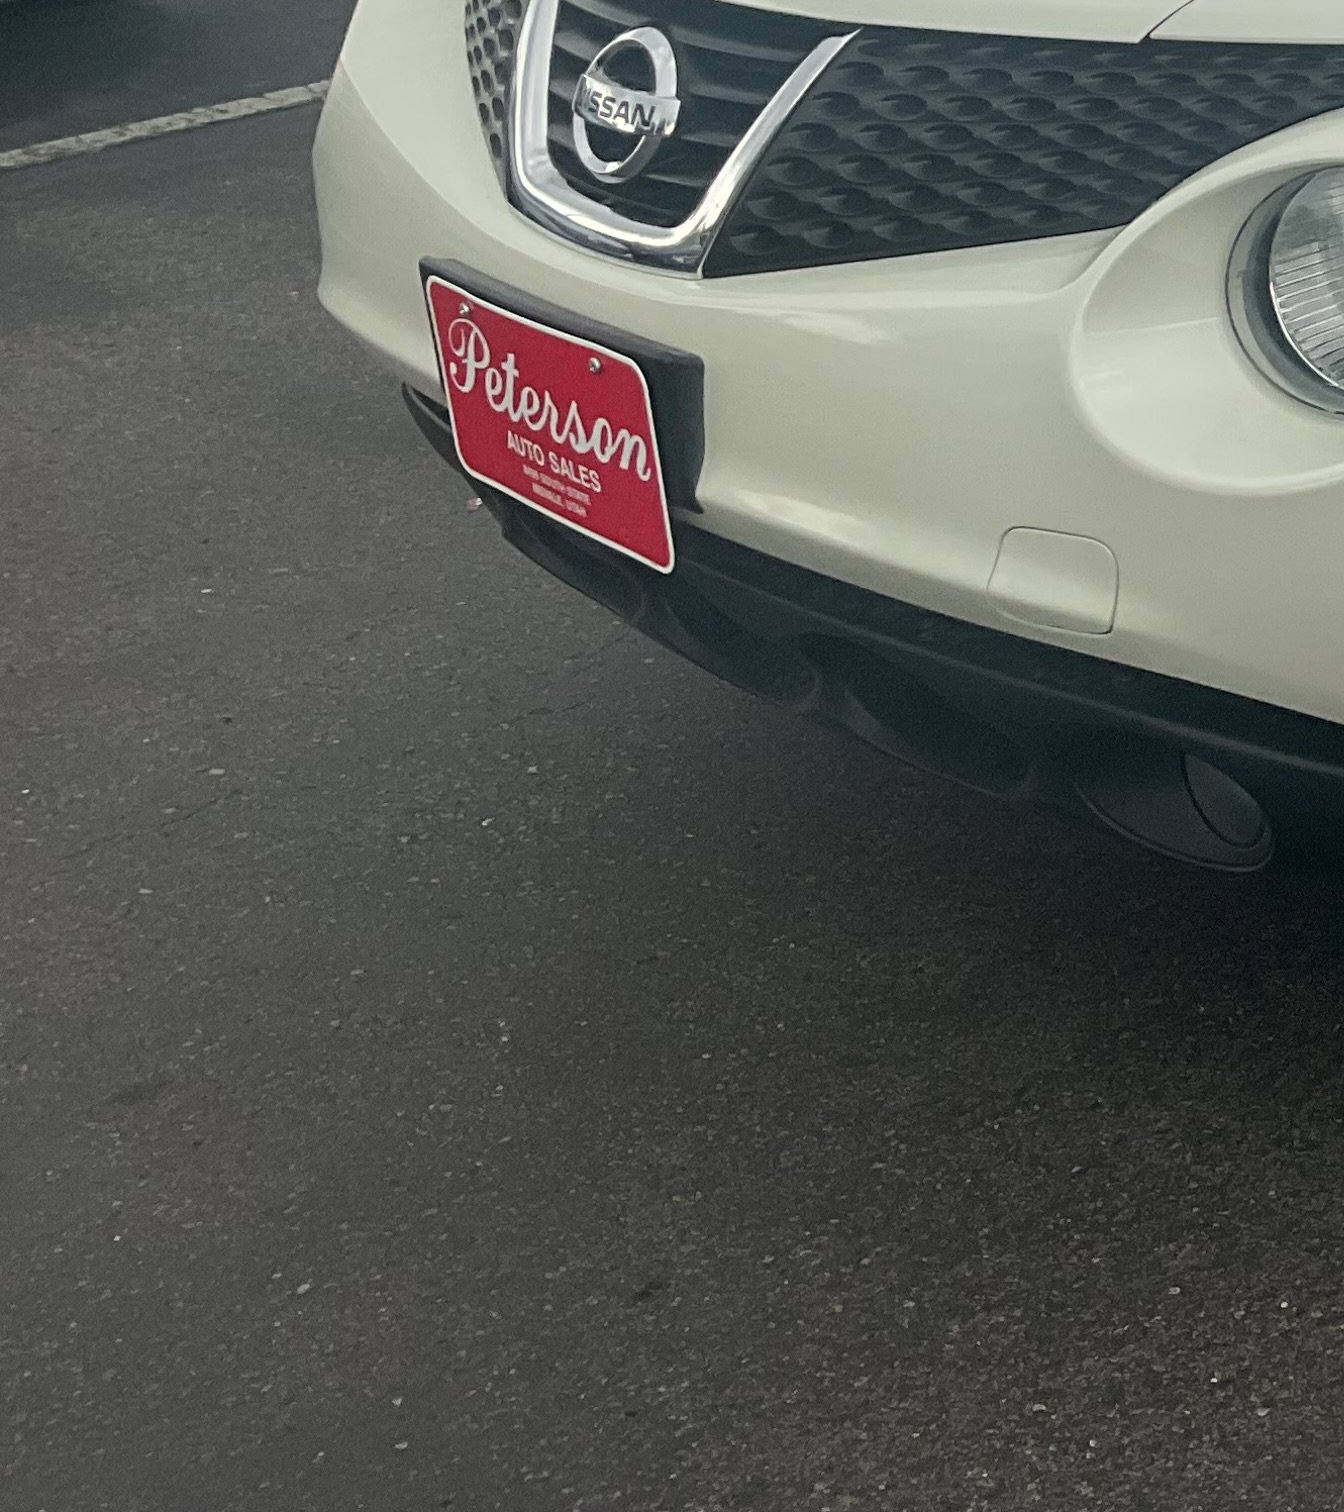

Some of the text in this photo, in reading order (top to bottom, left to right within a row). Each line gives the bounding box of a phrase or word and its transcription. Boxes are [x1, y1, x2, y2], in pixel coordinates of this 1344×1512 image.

[579, 88, 656, 126] ISSAN
[448, 318, 651, 481] Peterson
[507, 430, 544, 466] AUTO
[548, 451, 602, 492] SALES
